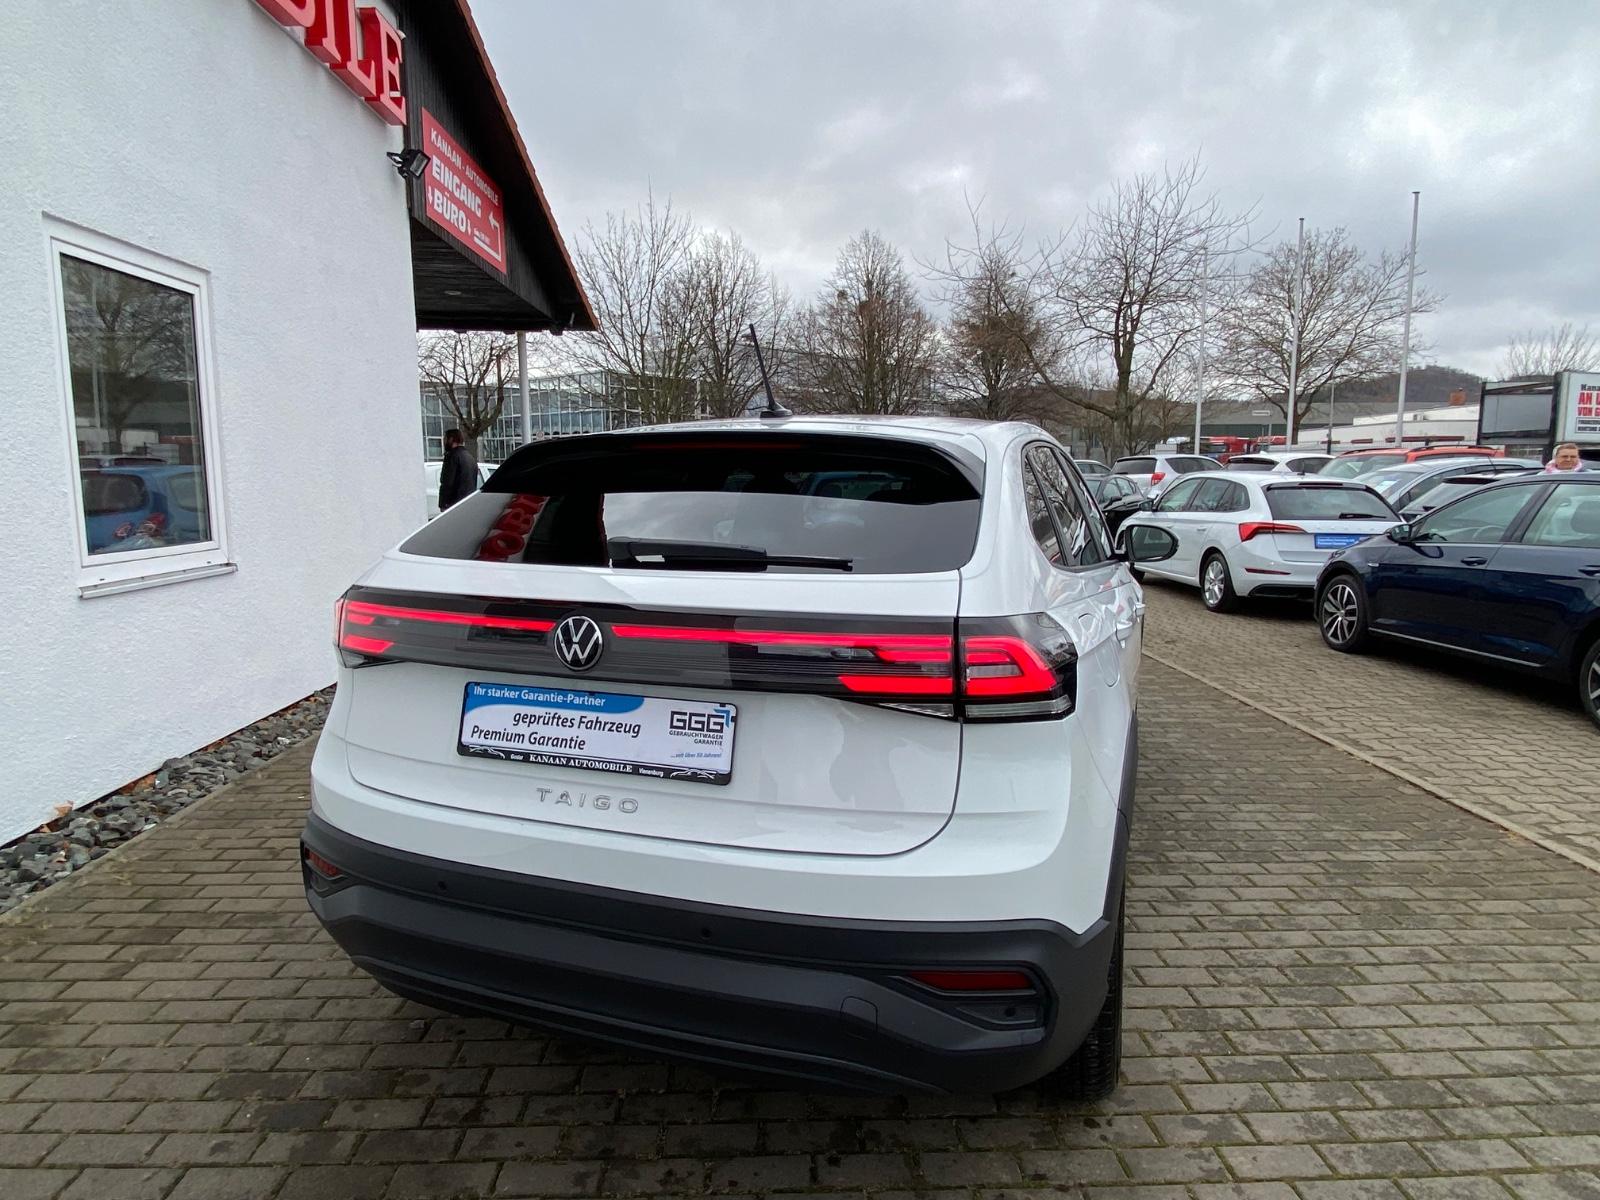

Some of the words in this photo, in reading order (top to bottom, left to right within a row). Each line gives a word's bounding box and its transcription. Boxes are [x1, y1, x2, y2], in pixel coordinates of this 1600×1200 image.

[430, 127, 462, 170] KANAAN
[465, 166, 498, 206] AUTOMOBILE
[432, 155, 482, 218] EINGANG
[433, 188, 466, 233] BÜRO
[474, 686, 485, 695] Ihr
[487, 688, 519, 699] starker
[521, 690, 606, 707] Garantie-Partner
[512, 712, 575, 728] geprüftes
[577, 715, 642, 738] Fahrzeug
[669, 710, 724, 733] GGG
[470, 725, 525, 744] Premium
[528, 731, 586, 750] Garantie
[669, 730, 723, 740] GEBRAUCHTWAGEN
[694, 738, 723, 746] GARANTIE
[530, 754, 568, 765] KANAAN
[568, 758, 633, 773] AUTOMOBILE
[536, 787, 639, 814] TAIGO
